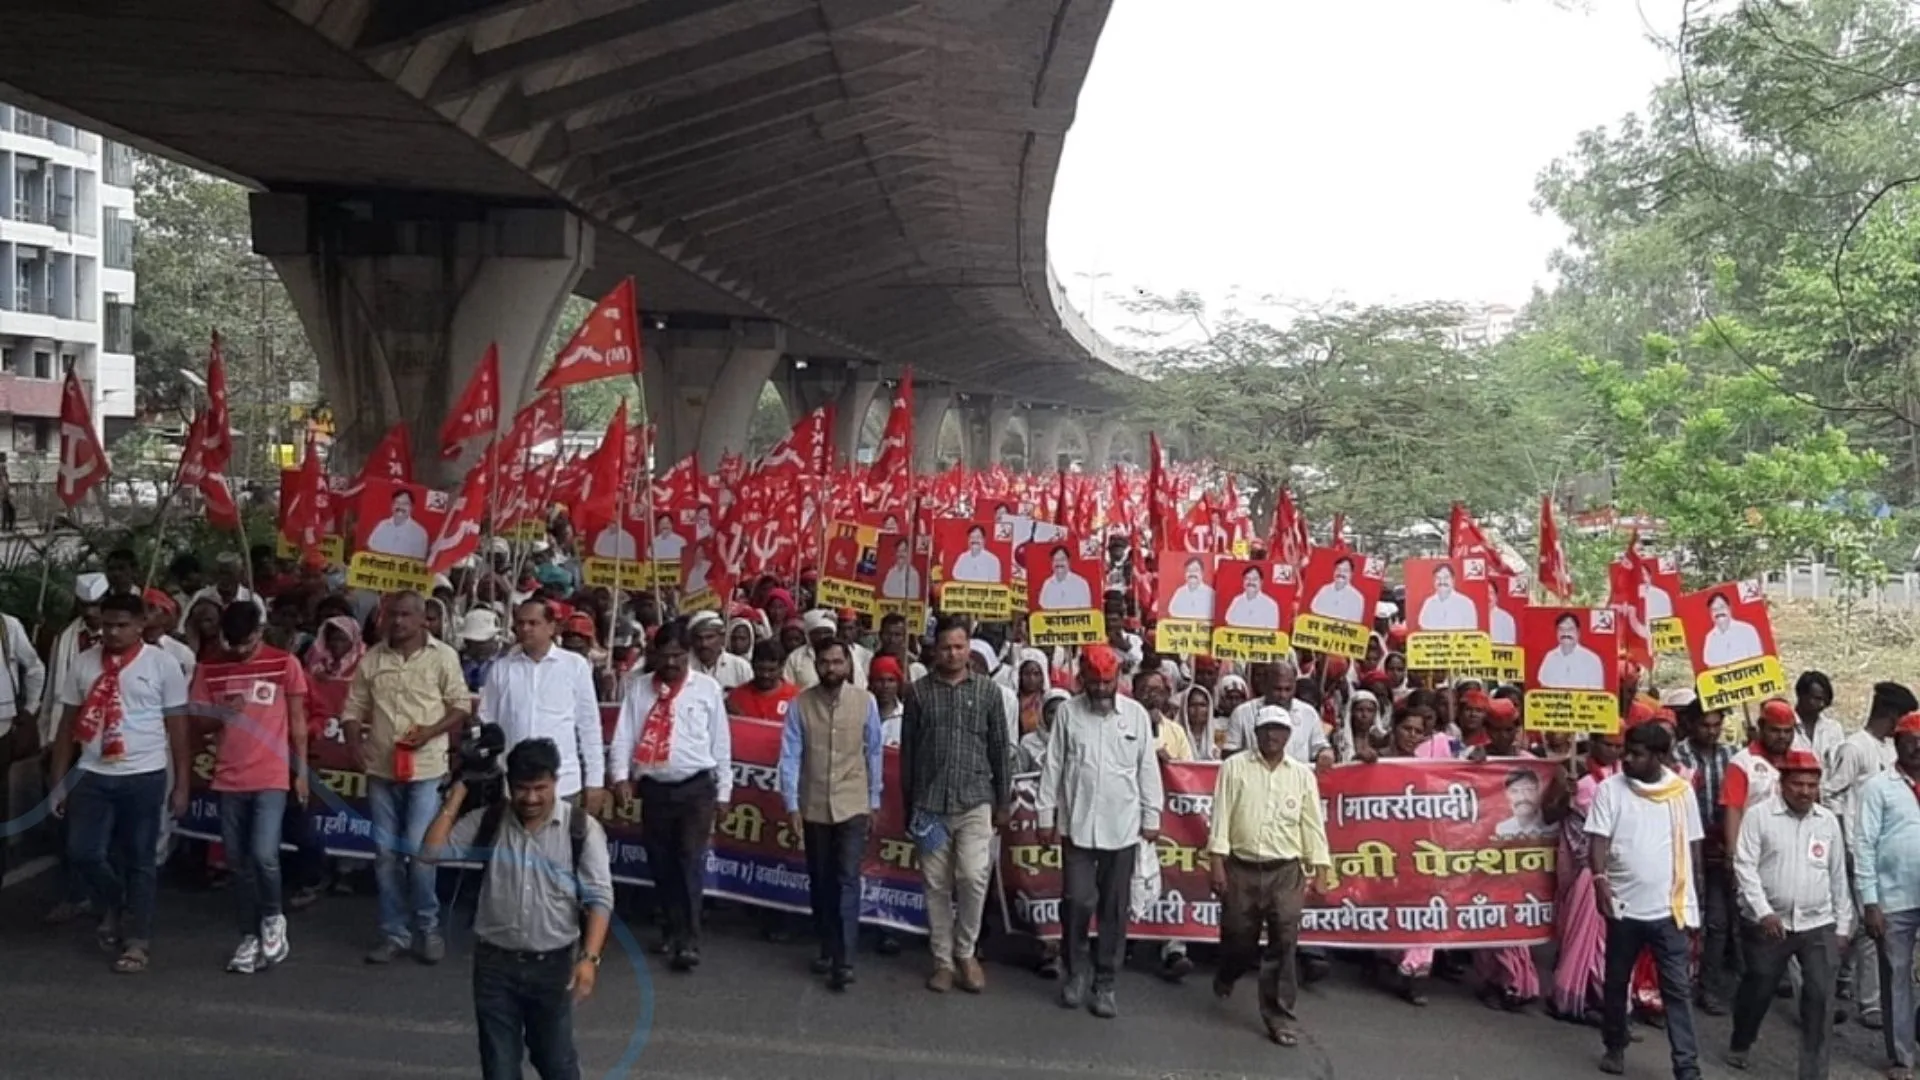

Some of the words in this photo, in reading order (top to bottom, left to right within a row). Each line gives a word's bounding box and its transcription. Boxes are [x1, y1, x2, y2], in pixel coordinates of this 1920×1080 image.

[1336, 783, 1478, 826] (मार्क्सवादी)
[1413, 839, 1556, 878] पेन्शन
[1300, 898, 1389, 932] नसभेवर
[1396, 895, 1449, 931] पायी
